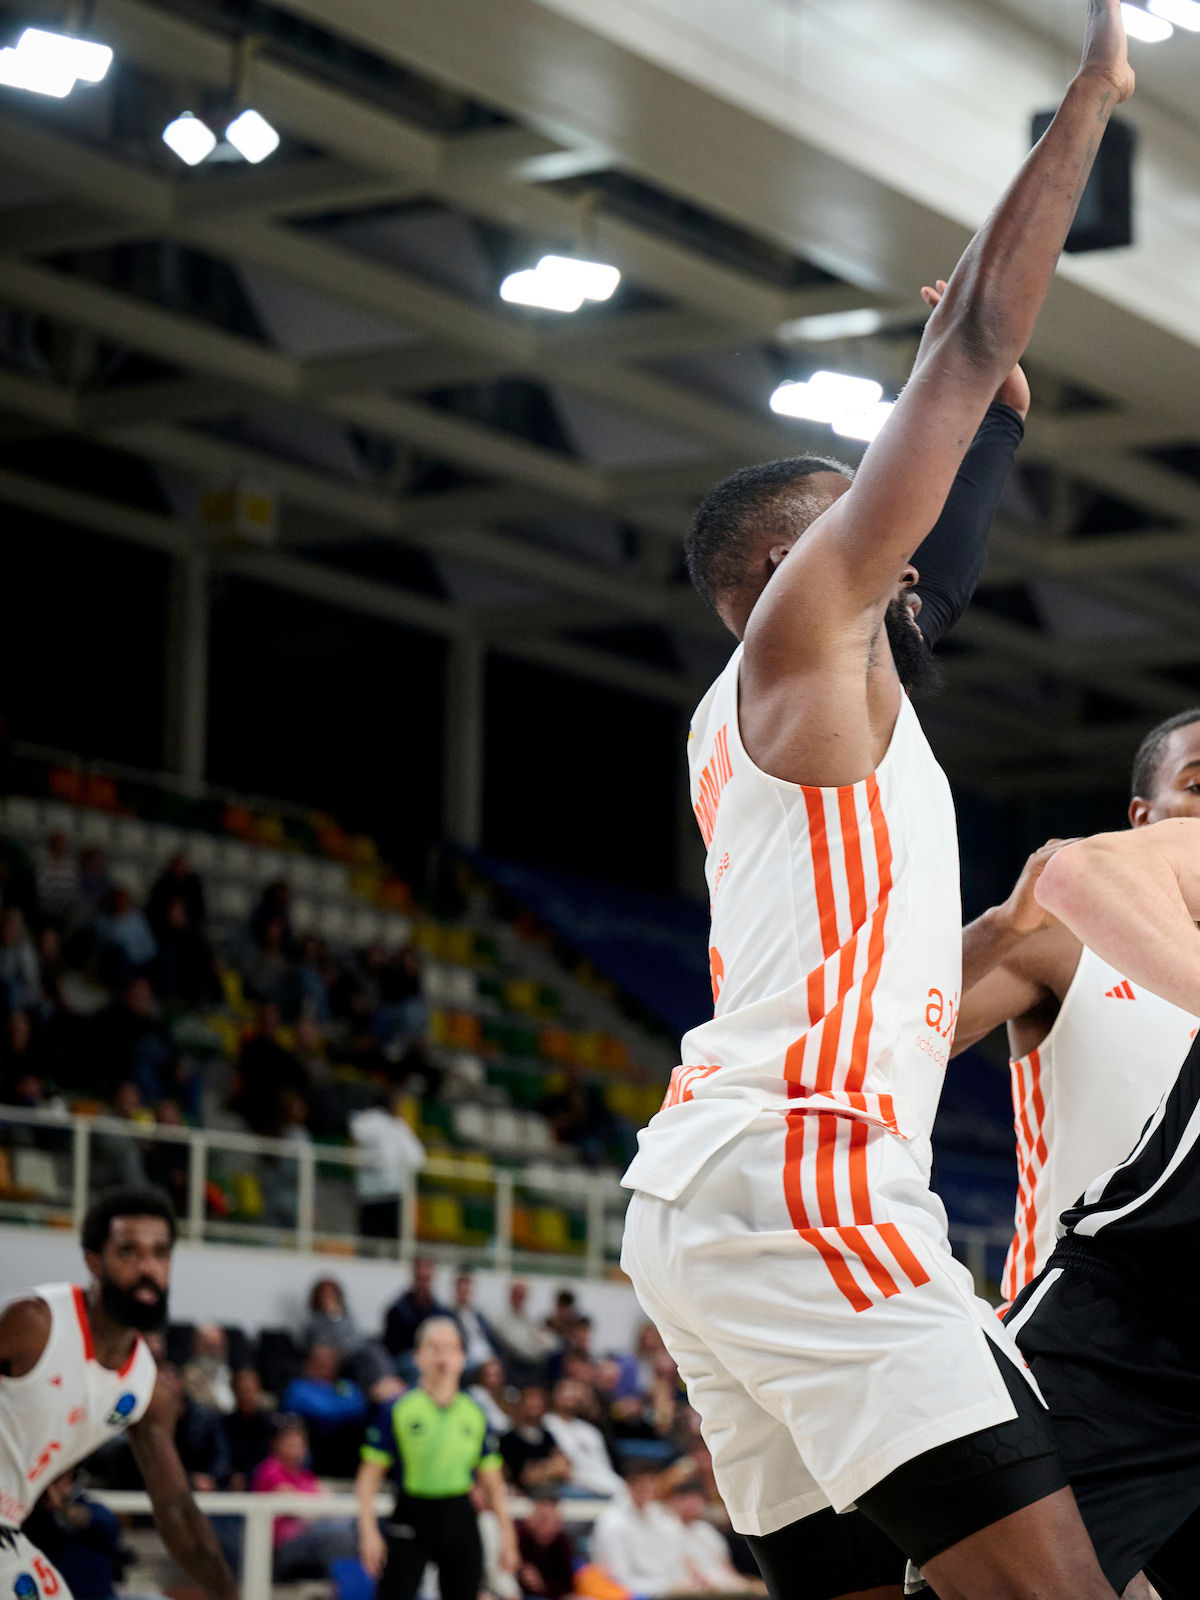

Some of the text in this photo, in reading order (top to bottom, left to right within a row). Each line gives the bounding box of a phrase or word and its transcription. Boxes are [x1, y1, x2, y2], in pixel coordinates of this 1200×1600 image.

[925, 988, 960, 1047] ax
[27, 1441, 62, 1482] 5
[31, 1556, 60, 1596] 5
